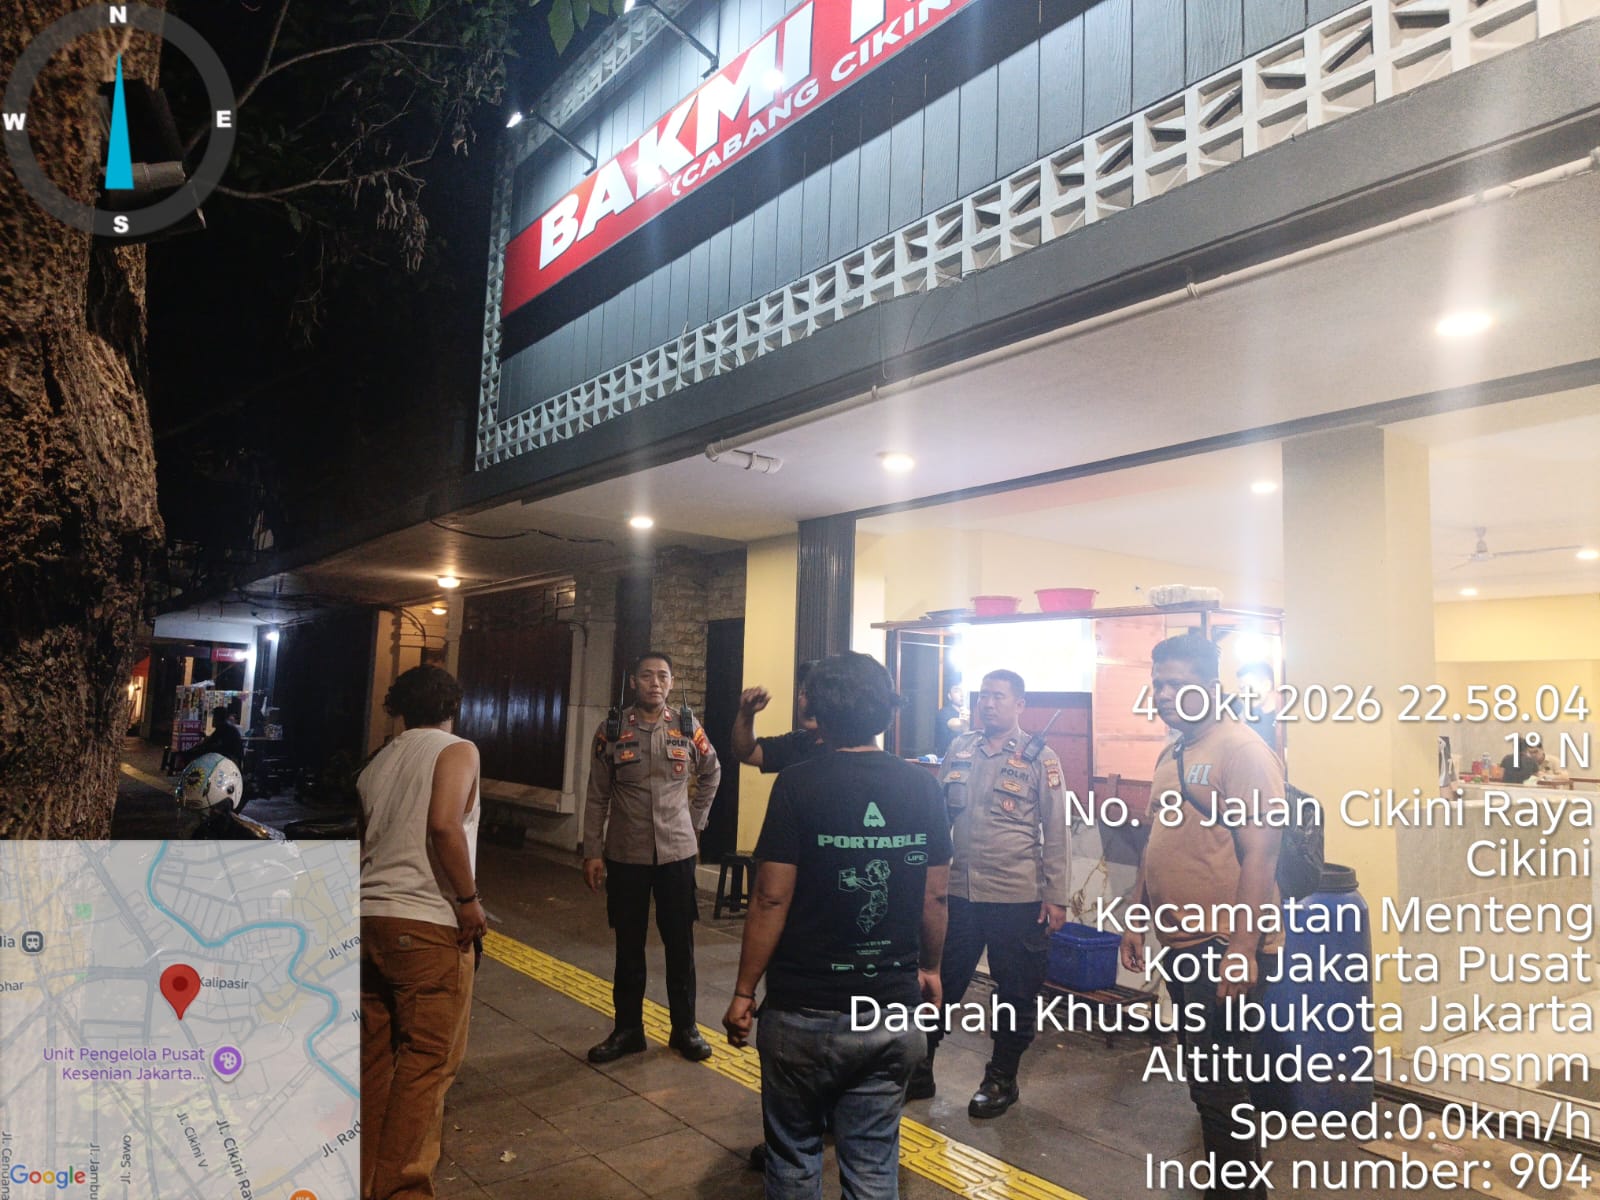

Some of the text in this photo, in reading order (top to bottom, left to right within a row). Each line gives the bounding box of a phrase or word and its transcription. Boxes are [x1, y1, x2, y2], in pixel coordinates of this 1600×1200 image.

[539, 0, 812, 270] BAKMI
[670, 76, 820, 198] (CABANG
[1000, 767, 1030, 781] POLRI
[818, 833, 928, 848] PORTABLE
